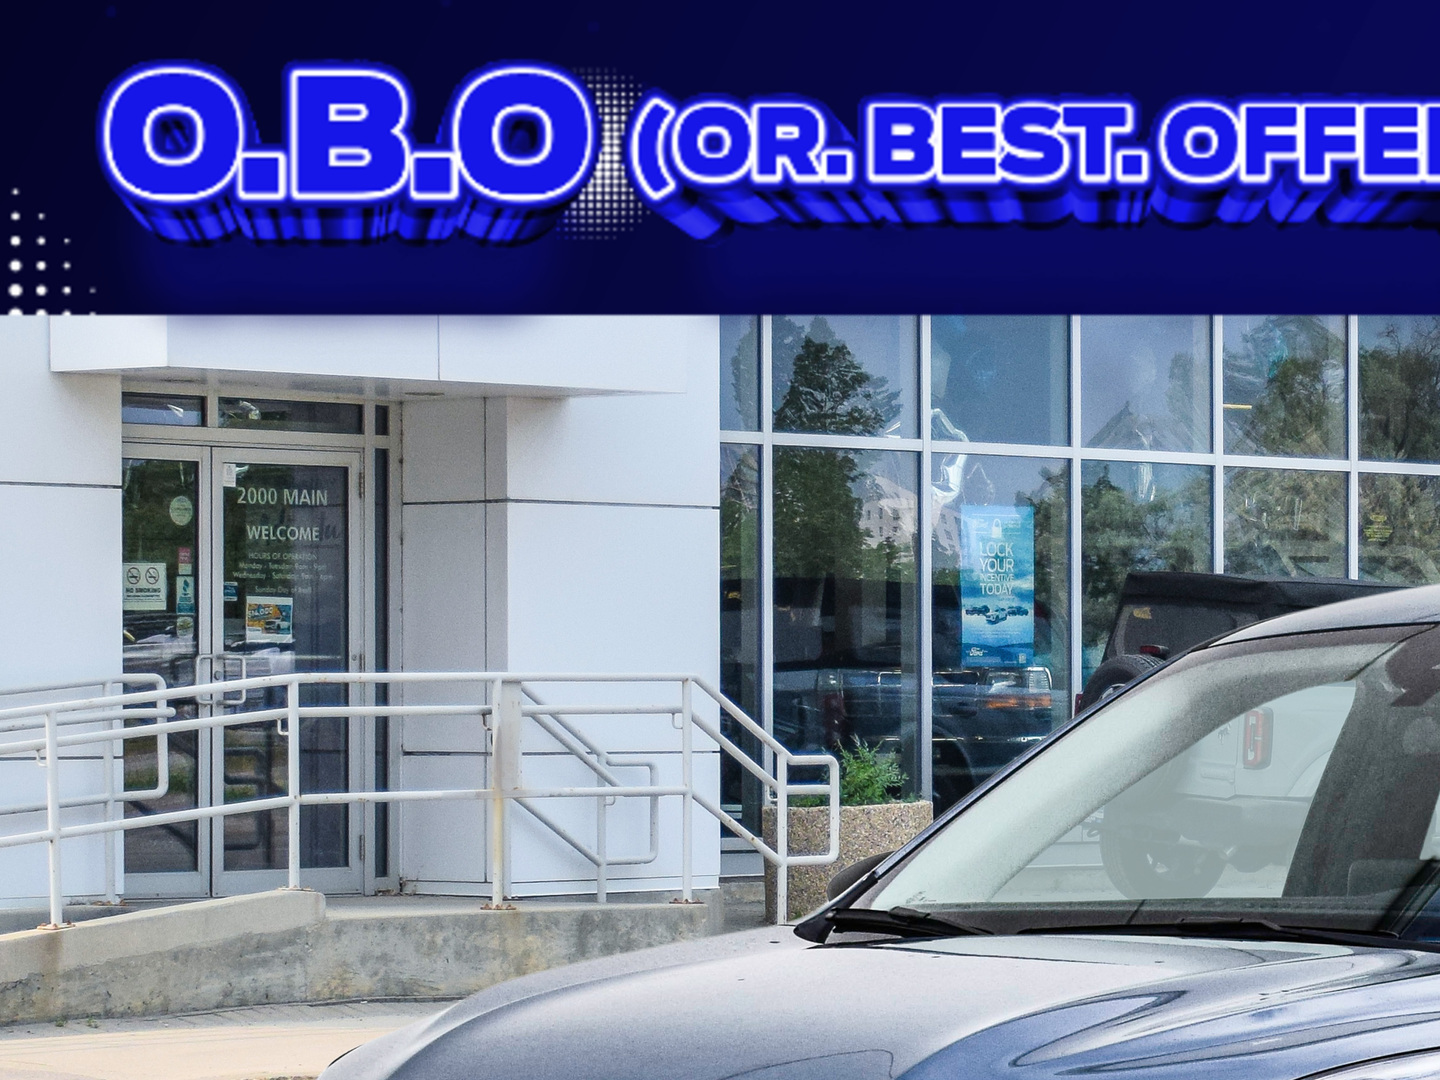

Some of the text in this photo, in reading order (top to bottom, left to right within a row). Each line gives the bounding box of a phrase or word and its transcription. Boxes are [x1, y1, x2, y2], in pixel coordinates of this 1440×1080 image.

[237, 486, 328, 506] 2000 MAIN
[245, 525, 320, 541] WELCOME
[980, 541, 1014, 557] LOCK
[980, 558, 1015, 572] YOUR
[980, 583, 1014, 595] TODAY
